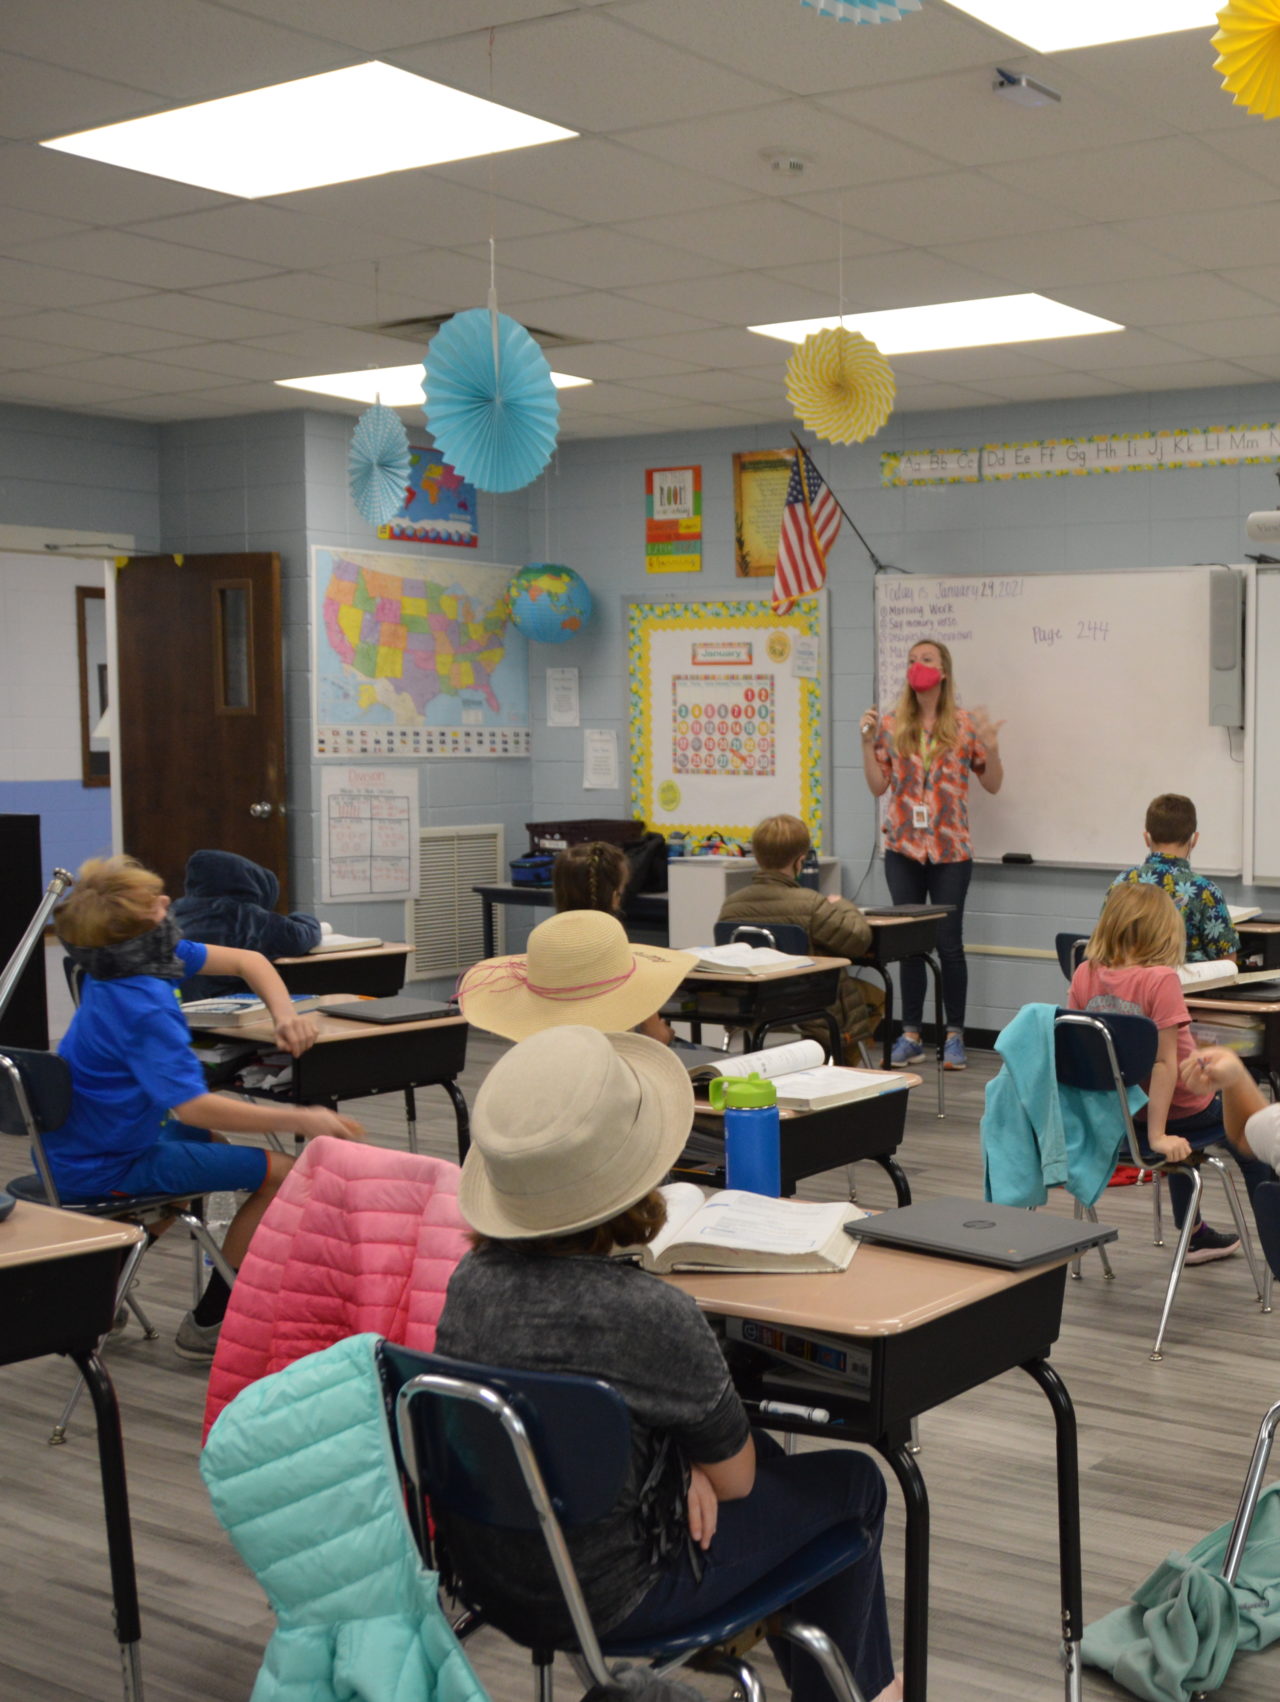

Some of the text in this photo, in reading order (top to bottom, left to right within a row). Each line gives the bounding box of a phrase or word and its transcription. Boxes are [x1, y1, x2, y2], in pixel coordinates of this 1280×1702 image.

[956, 453, 974, 469] Cc
[986, 450, 1006, 467] Dd
[1014, 448, 1031, 465] Ee
[1040, 446, 1056, 463] Ff
[1065, 444, 1086, 467] Gg
[1096, 442, 1117, 459] Hh
[1126, 440, 1138, 457] Ii
[1148, 438, 1164, 461] Jj
[1173, 437, 1194, 454] Kk
[1204, 435, 1220, 451] Ll
[1229, 432, 1260, 450] Mm
[936, 581, 979, 600] January
[1033, 620, 1111, 645] Page 244
[701, 649, 742, 658] January
